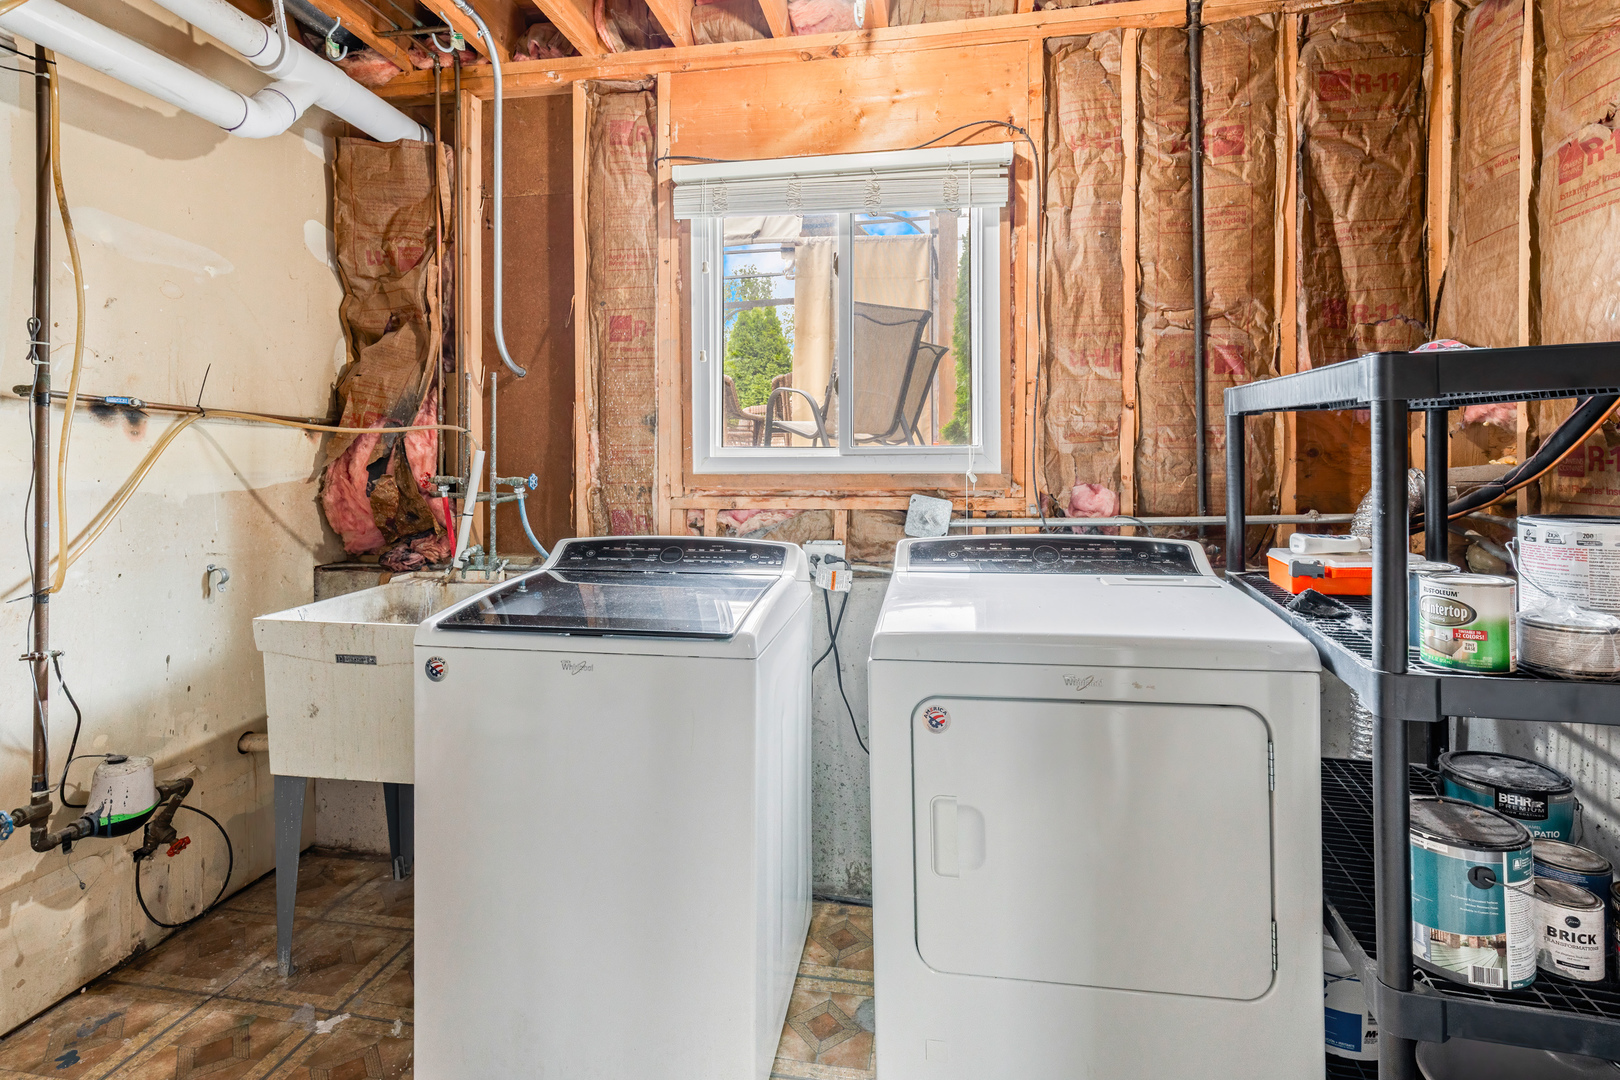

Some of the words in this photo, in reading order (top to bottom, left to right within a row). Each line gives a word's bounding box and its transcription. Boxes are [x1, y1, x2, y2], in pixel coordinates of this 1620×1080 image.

[1354, 71, 1400, 95] R-11
[1350, 302, 1400, 327] R-11
[1462, 633, 1485, 641] COLORS!
[924, 706, 947, 719] AMERICA
[1498, 792, 1532, 807] BEHR
[1498, 802, 1545, 813] PREMIUM
[1533, 830, 1561, 839] PATIO
[1546, 925, 1597, 945] BRICK
